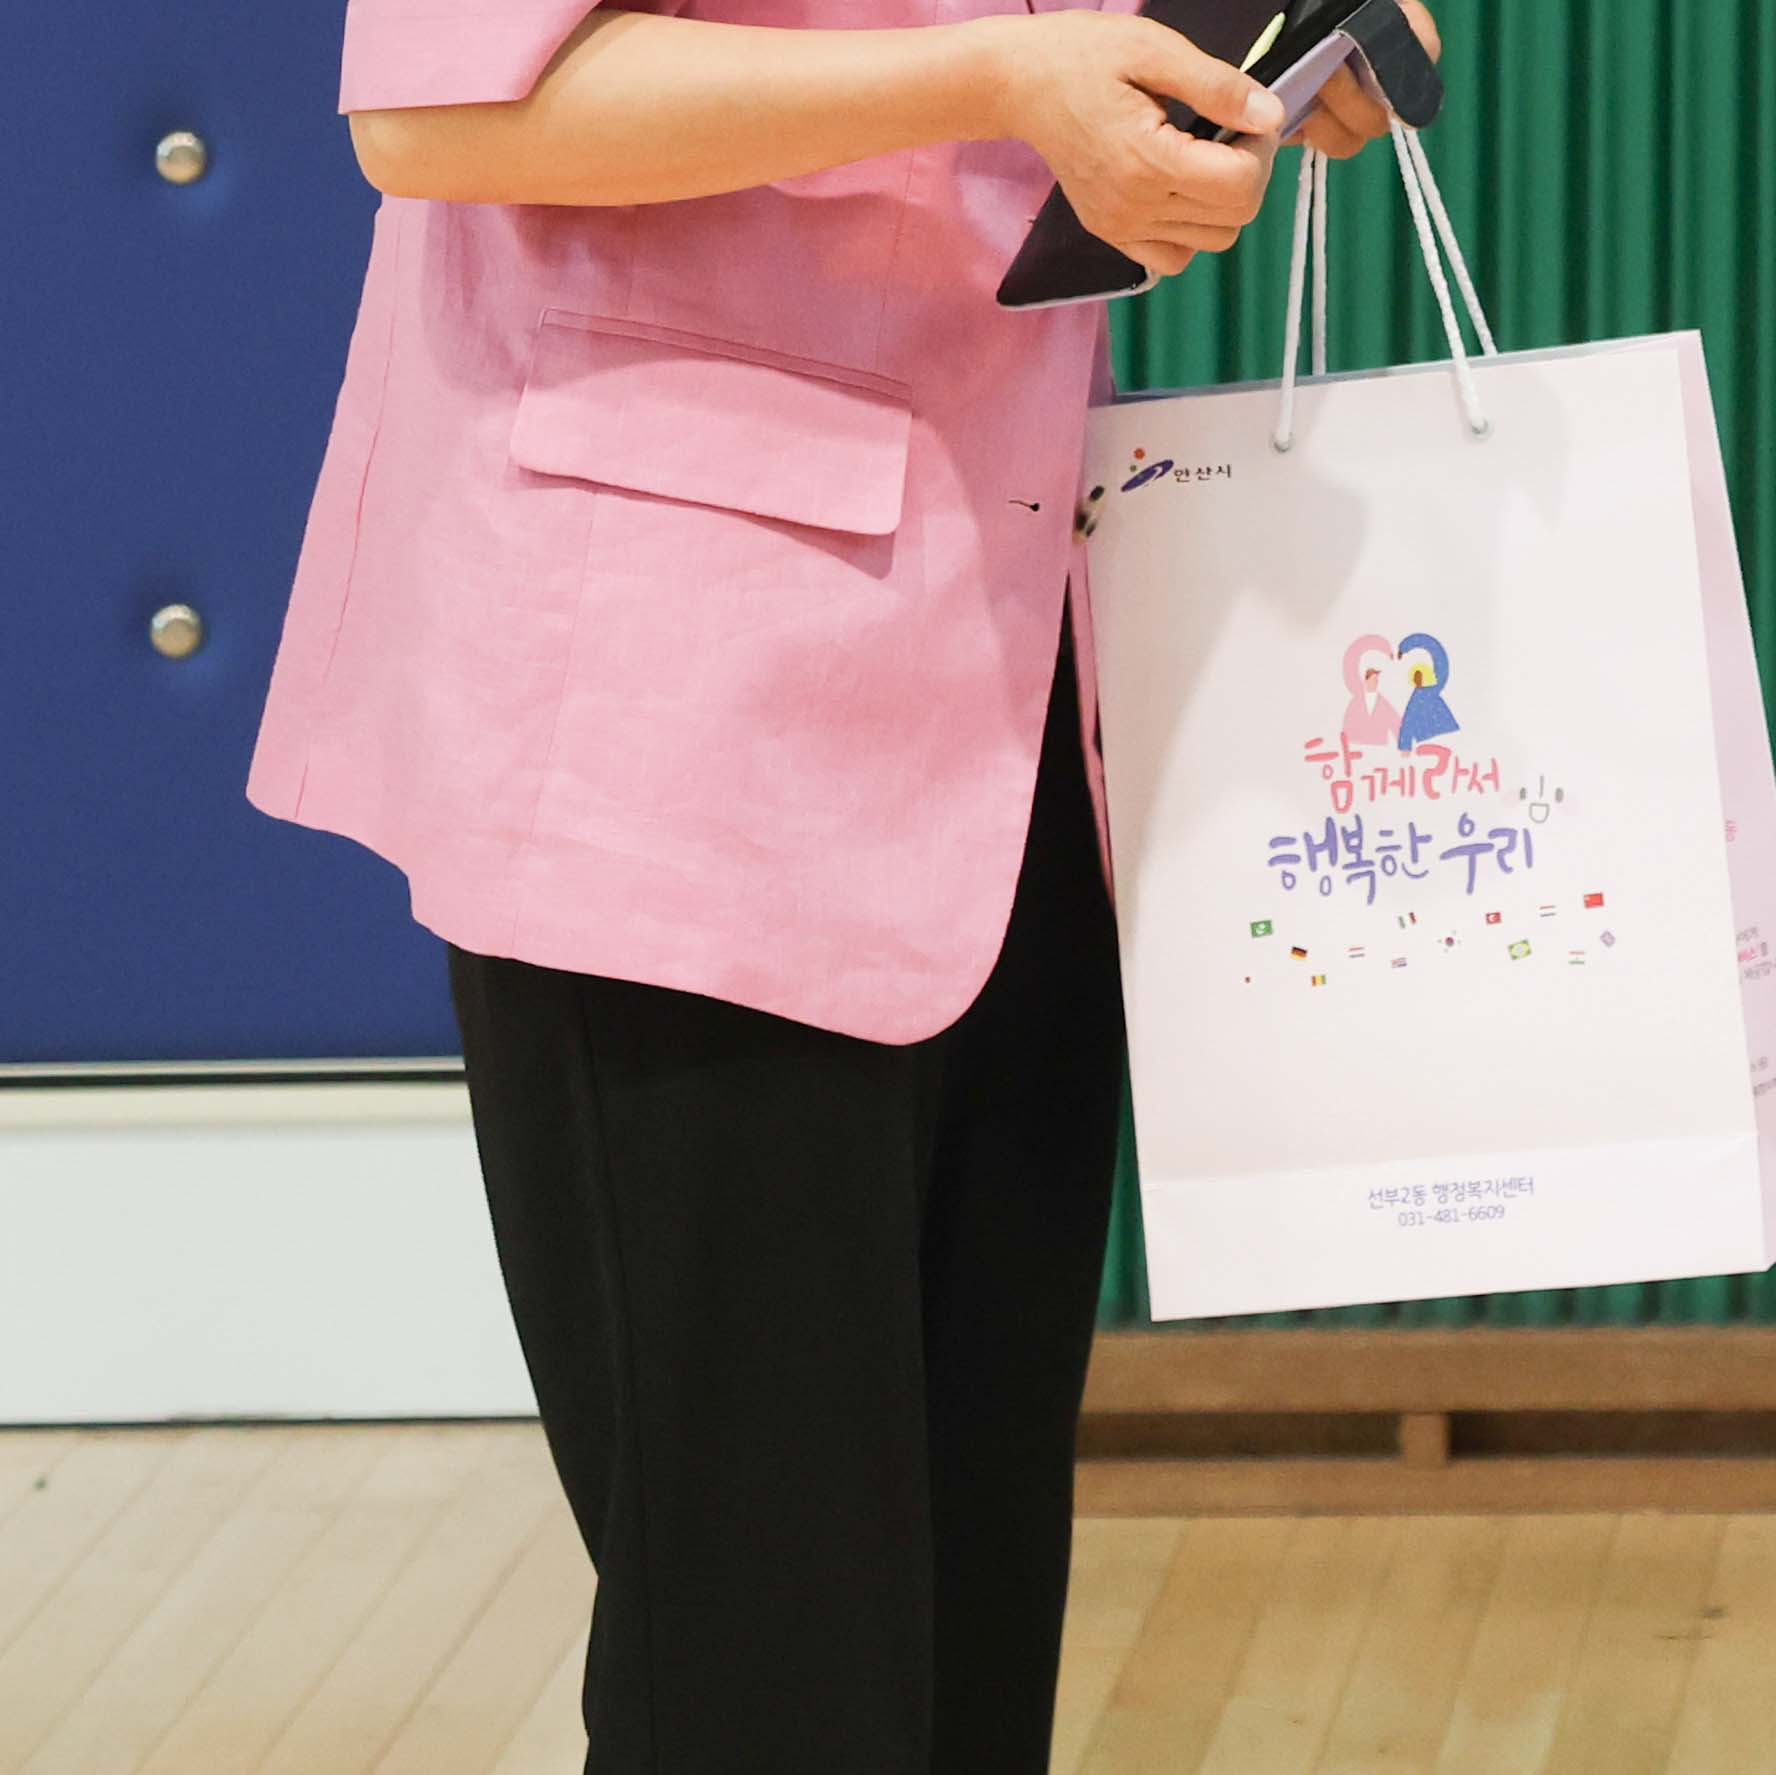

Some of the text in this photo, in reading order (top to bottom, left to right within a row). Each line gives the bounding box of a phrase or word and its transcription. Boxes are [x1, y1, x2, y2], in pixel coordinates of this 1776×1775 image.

[1174, 464, 1231, 483] 안산시
[1304, 731, 1500, 814] 함께라서
[1268, 812, 1533, 906] 행복한 우리
[1368, 1176, 1534, 1210] 선부2동 행정복지센터
[1398, 1204, 1505, 1227] 031-481-6609
